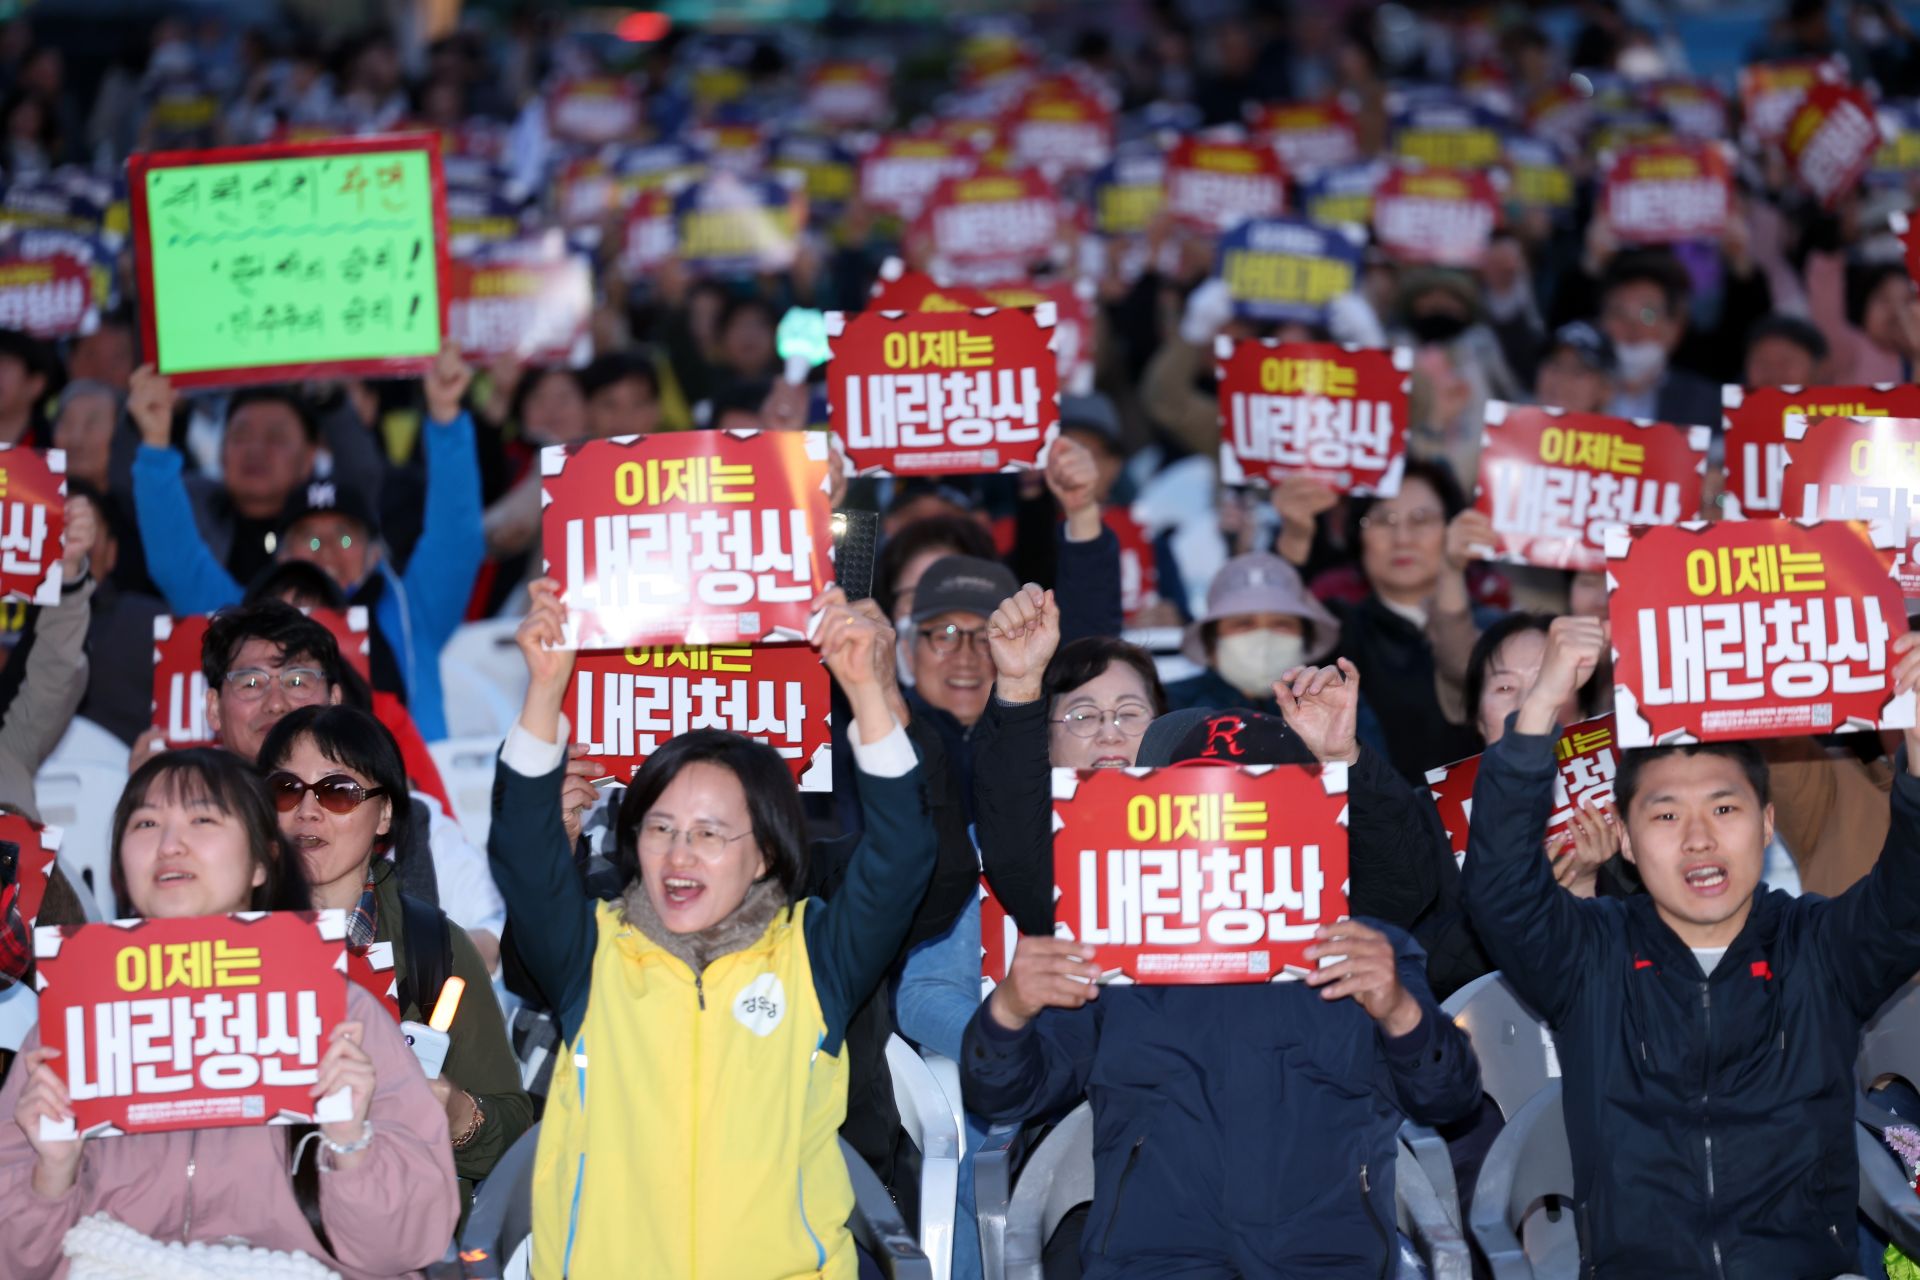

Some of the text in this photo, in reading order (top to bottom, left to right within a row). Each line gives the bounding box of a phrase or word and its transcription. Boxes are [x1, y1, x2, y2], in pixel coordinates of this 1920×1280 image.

[884, 330, 994, 368] 이제는
[1261, 357, 1357, 397] 이제는
[846, 367, 1041, 449] 내란청산
[1231, 391, 1393, 470] 내란청산
[1539, 427, 1644, 474] 이제는
[614, 456, 755, 506] 이제는
[566, 509, 813, 609] 내란청산
[1686, 544, 1826, 596] 이제는
[1638, 596, 1890, 706] 내란청산
[1202, 715, 1246, 756] R
[1127, 793, 1268, 842] 이제는
[1079, 845, 1324, 945] 내란청산
[115, 939, 262, 992] 이제는
[65, 990, 322, 1100] 내란청산
